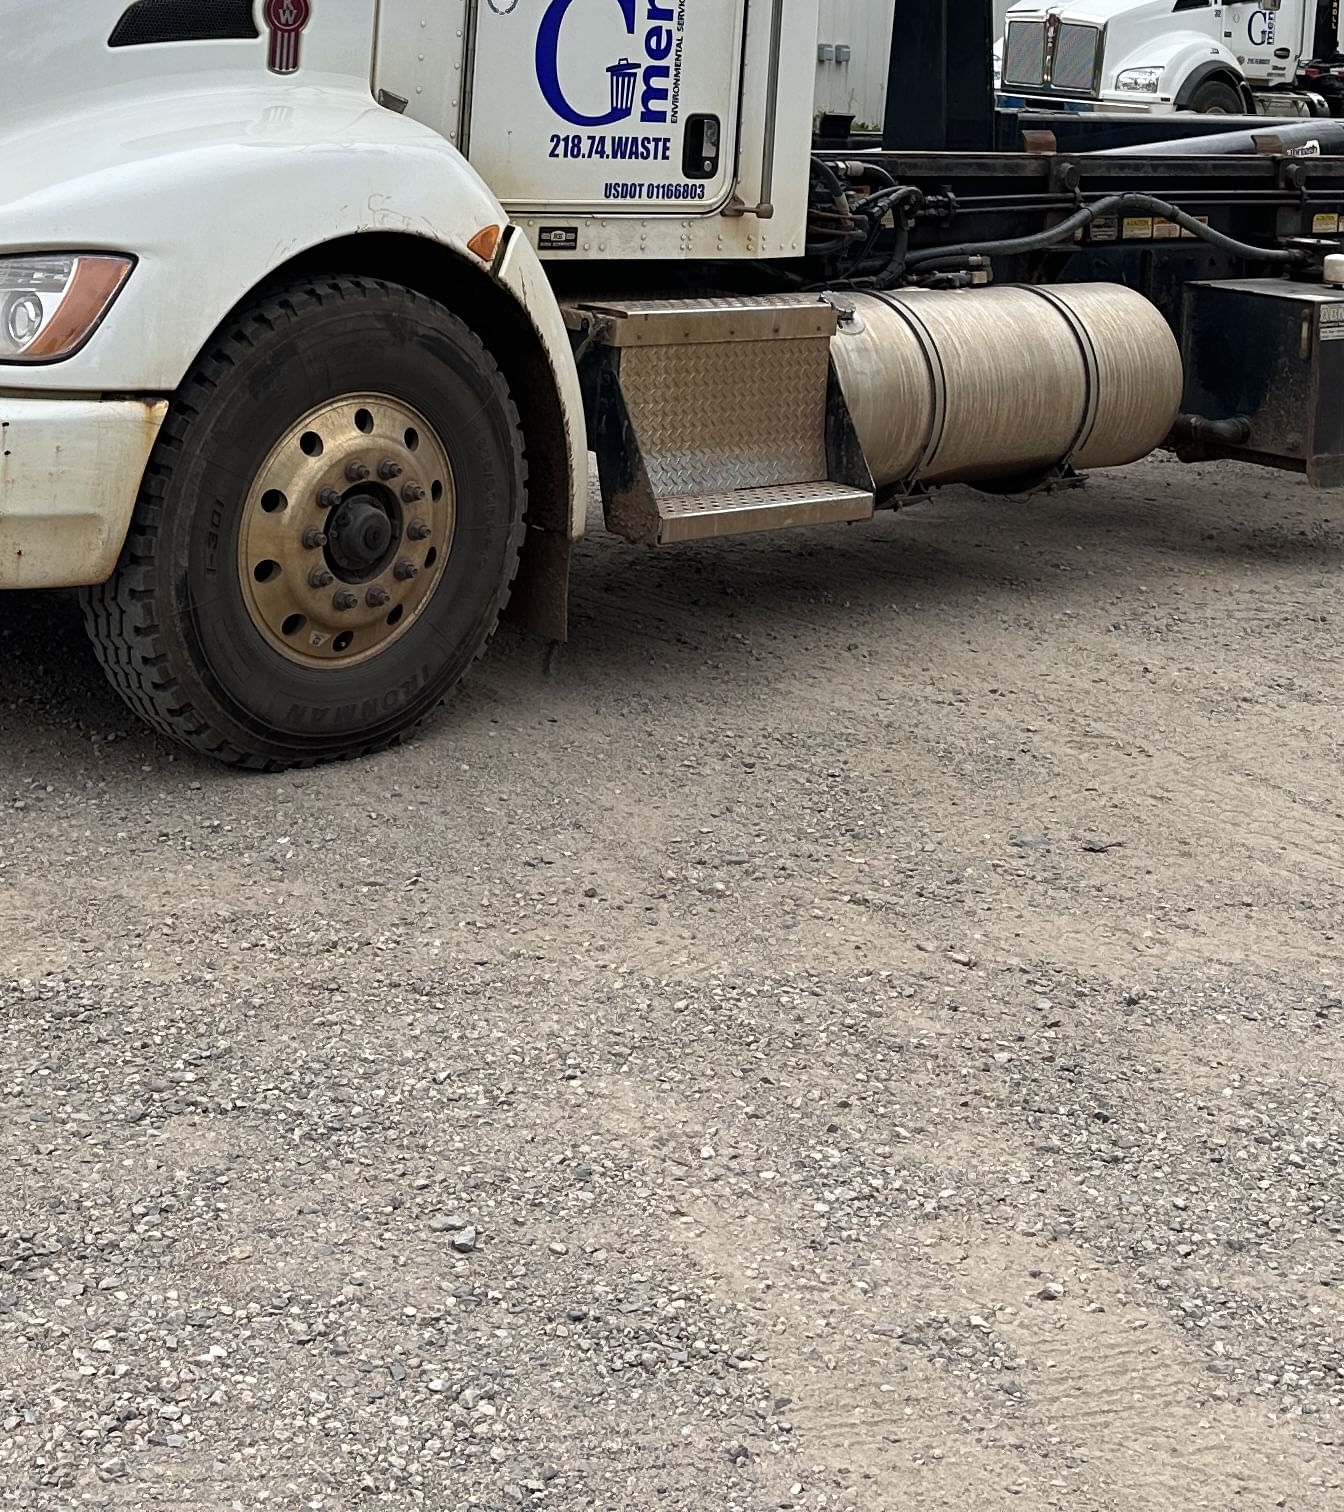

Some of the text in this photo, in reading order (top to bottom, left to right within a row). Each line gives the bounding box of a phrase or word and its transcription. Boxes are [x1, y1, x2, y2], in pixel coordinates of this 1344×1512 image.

[1247, 10, 1267, 46] G
[670, 35, 684, 124] ENVIRONMENTAL
[548, 133, 671, 161] 218.74.WASTE
[603, 182, 706, 201] USDOT 01166803
